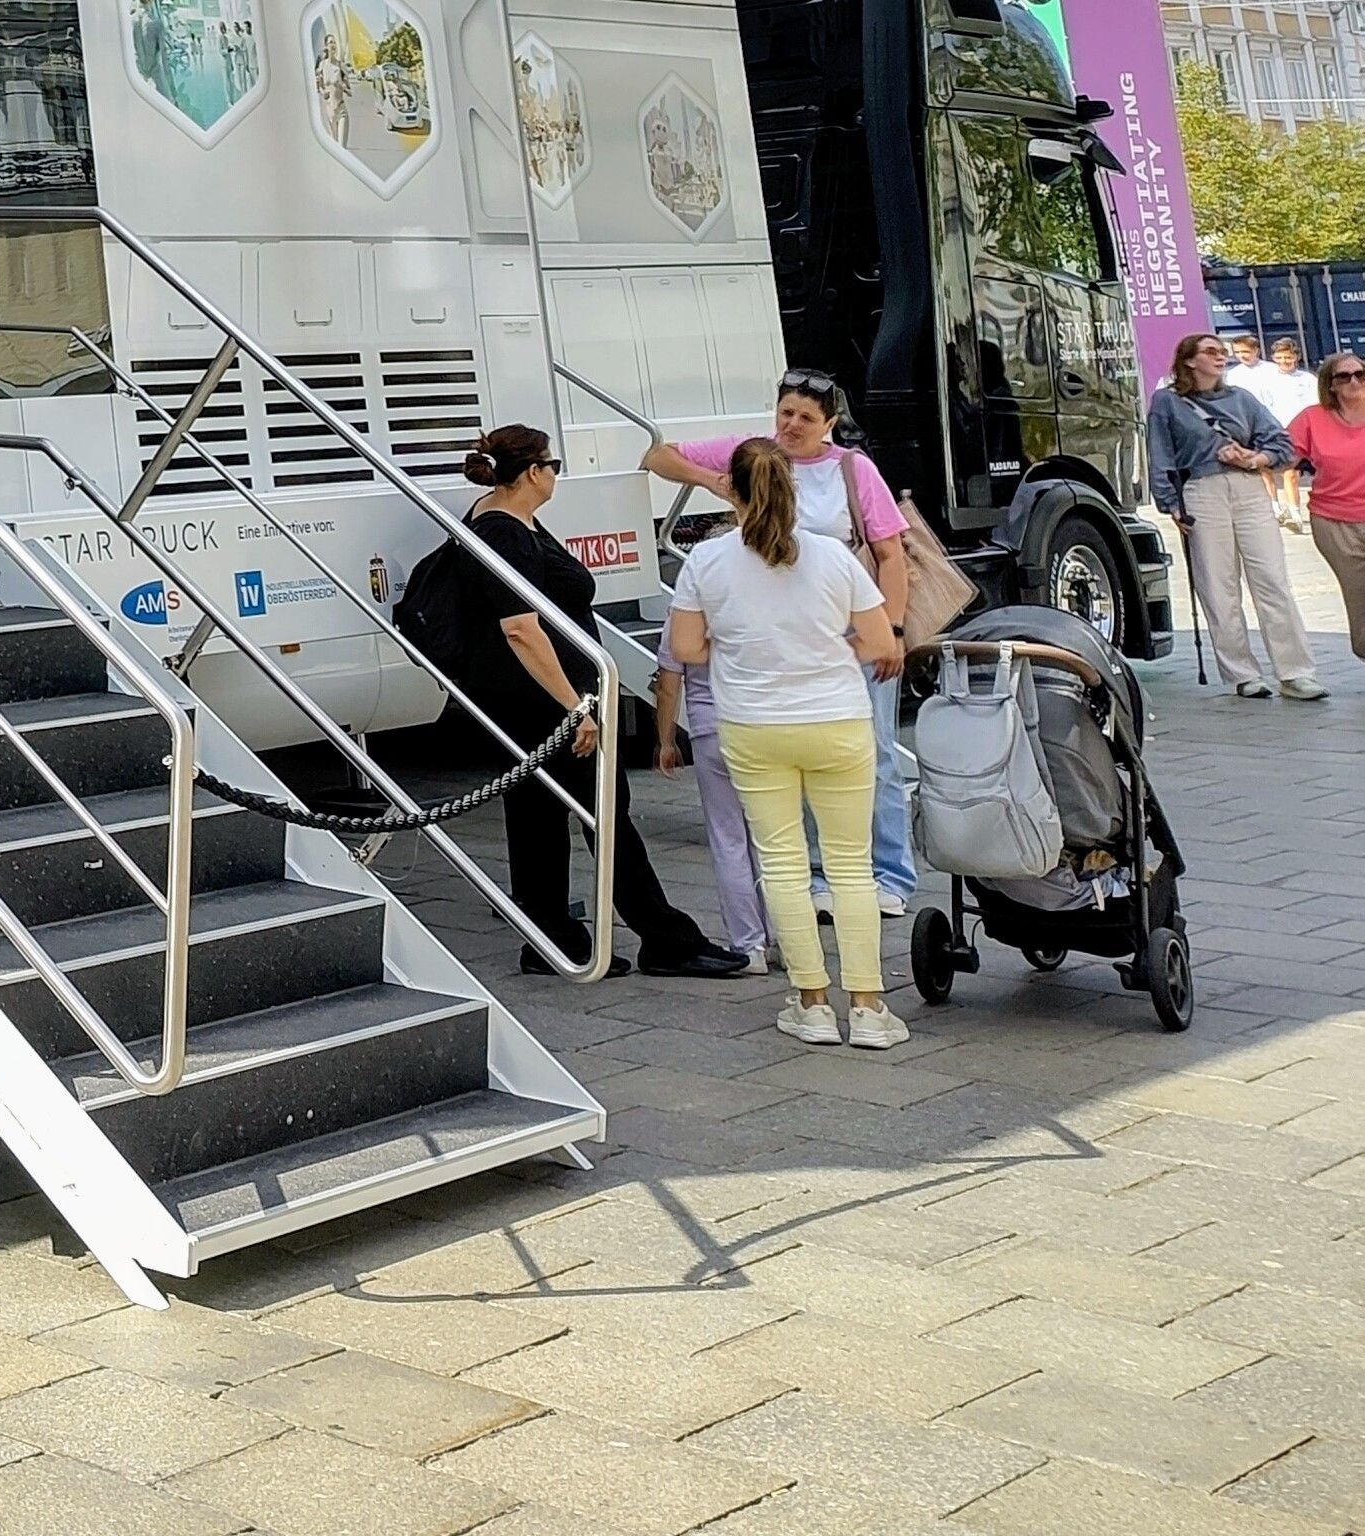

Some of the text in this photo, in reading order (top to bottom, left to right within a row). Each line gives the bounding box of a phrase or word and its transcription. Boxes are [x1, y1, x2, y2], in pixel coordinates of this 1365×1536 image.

[1119, 71, 1170, 317] NEGOTIATING
[1145, 137, 1187, 316] HUMANITY
[1129, 228, 1151, 317] BEGINS
[1057, 321, 1092, 344] STAR
[238, 520, 336, 540] Eine Initive von:
[43, 530, 114, 565] TAR
[566, 537, 618, 563] WKO
[135, 590, 181, 615] AMS
[240, 575, 259, 608] iv
[268, 587, 338, 605] OBERÖSTERREICH
